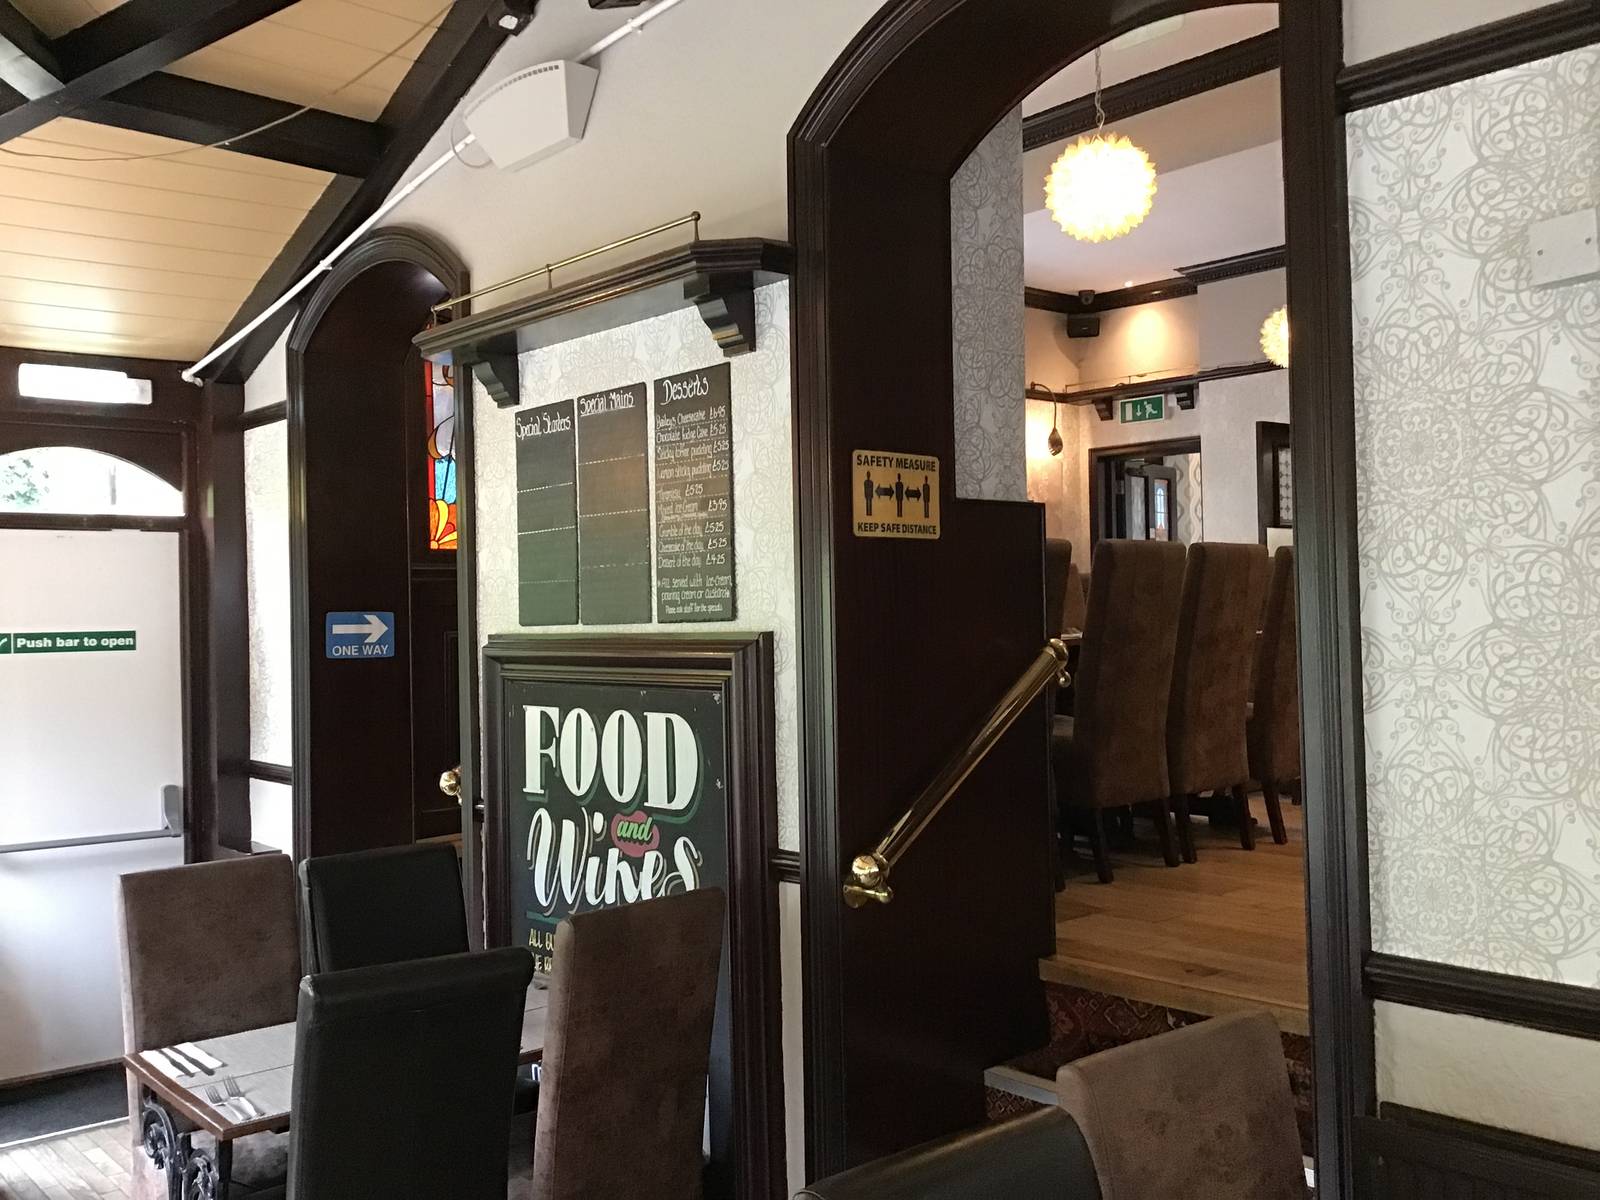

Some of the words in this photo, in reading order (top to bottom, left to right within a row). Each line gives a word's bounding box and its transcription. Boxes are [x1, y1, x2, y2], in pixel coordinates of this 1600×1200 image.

[660, 374, 709, 405] Desserts
[580, 394, 607, 415] Special
[609, 391, 634, 409] Mains
[516, 416, 542, 440] Special
[543, 412, 571, 434] Starters
[857, 454, 894, 469] SAFETY
[896, 457, 936, 472] MEASURE
[857, 521, 879, 532] KEEP
[881, 523, 901, 533] SAFE
[902, 524, 937, 535] DISTANCE
[16, 637, 52, 648] Push
[56, 636, 80, 648] bar
[83, 636, 98, 647] to
[100, 637, 134, 648] open
[332, 645, 359, 657] ONE
[362, 644, 389, 656] WAY
[523, 705, 698, 810] FOOD
[616, 817, 652, 841] and
